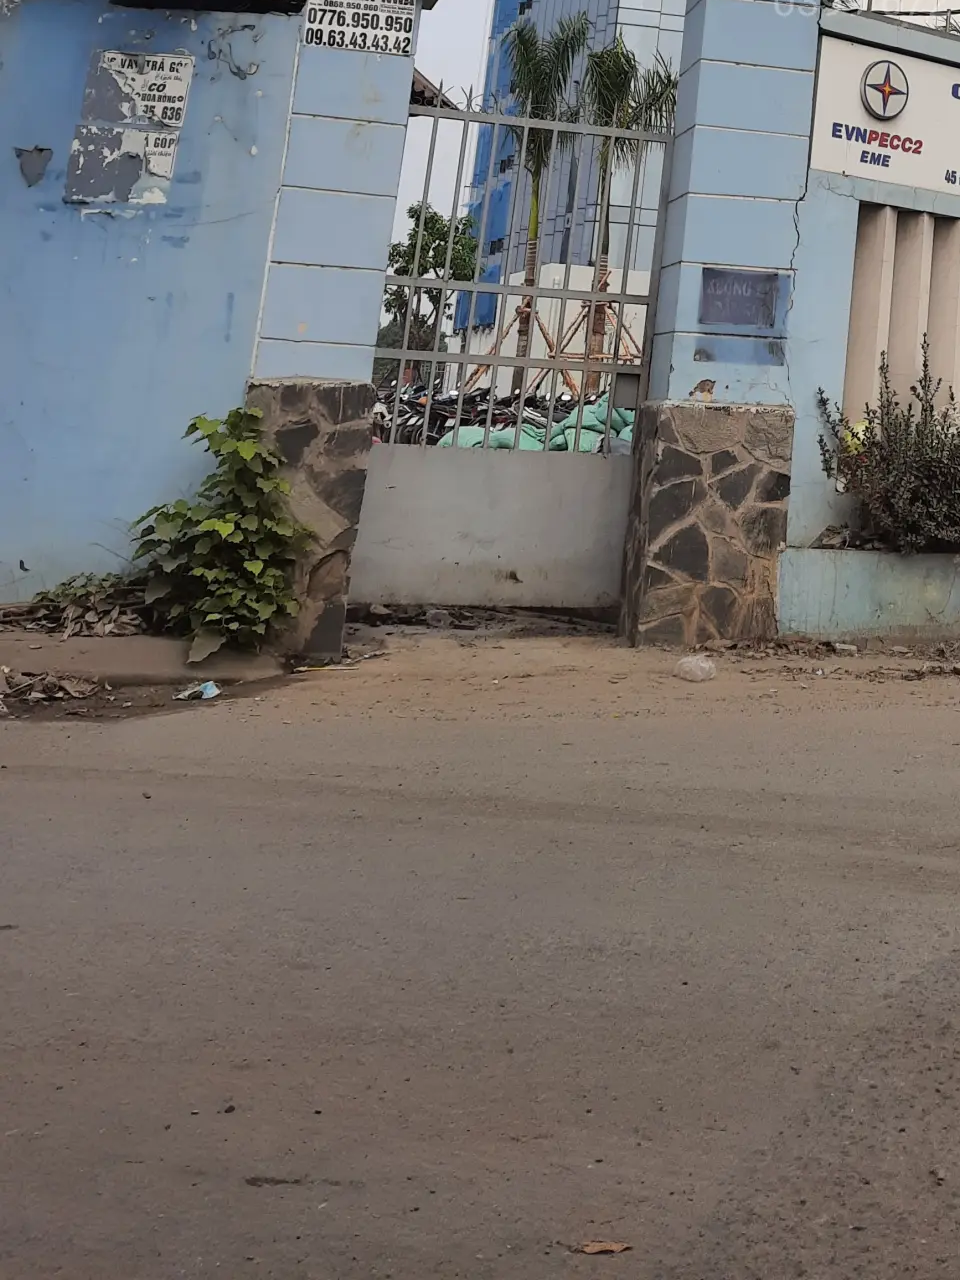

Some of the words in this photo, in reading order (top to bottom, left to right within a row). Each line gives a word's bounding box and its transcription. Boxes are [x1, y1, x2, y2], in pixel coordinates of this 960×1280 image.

[307, 7, 413, 34] 0776.950.950
[305, 27, 411, 54] 09.63.43.43.42
[145, 57, 165, 71] TRẢ
[147, 81, 167, 92] CÓ
[161, 106, 182, 122] 636
[831, 122, 923, 154] EVNPECC2
[860, 150, 891, 167] EME
[944, 170, 957, 185] 45
